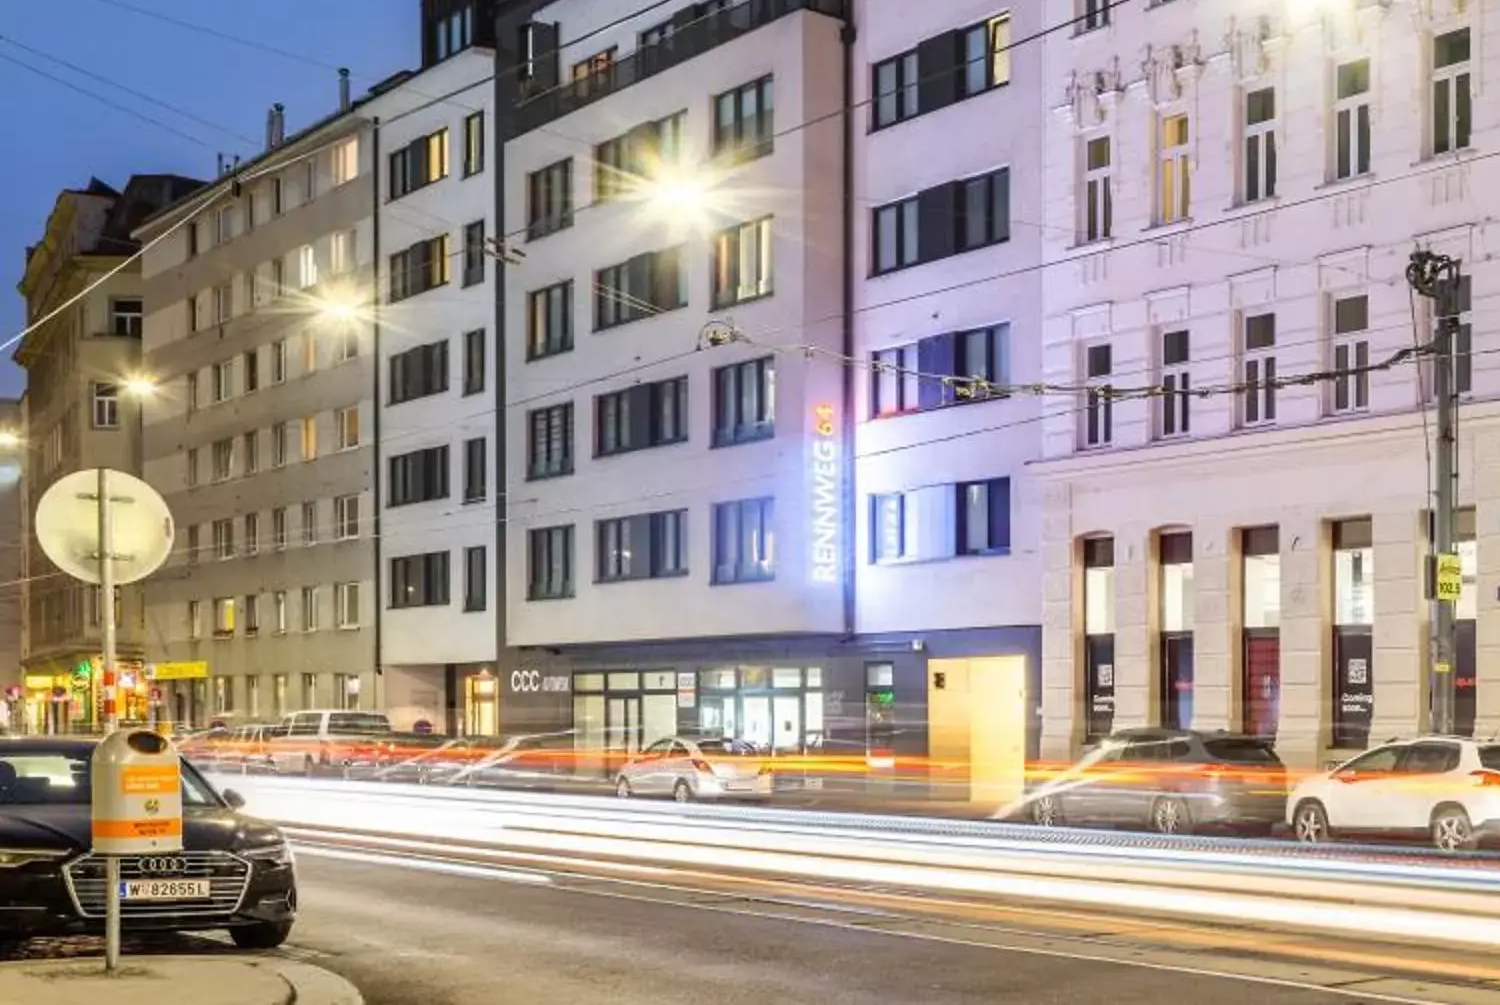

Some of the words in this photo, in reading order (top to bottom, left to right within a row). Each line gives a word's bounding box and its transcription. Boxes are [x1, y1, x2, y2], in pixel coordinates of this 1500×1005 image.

[815, 404, 834, 436] 64
[811, 441, 837, 583] RENNWEG
[511, 670, 540, 692] CCC
[129, 883, 141, 896] W
